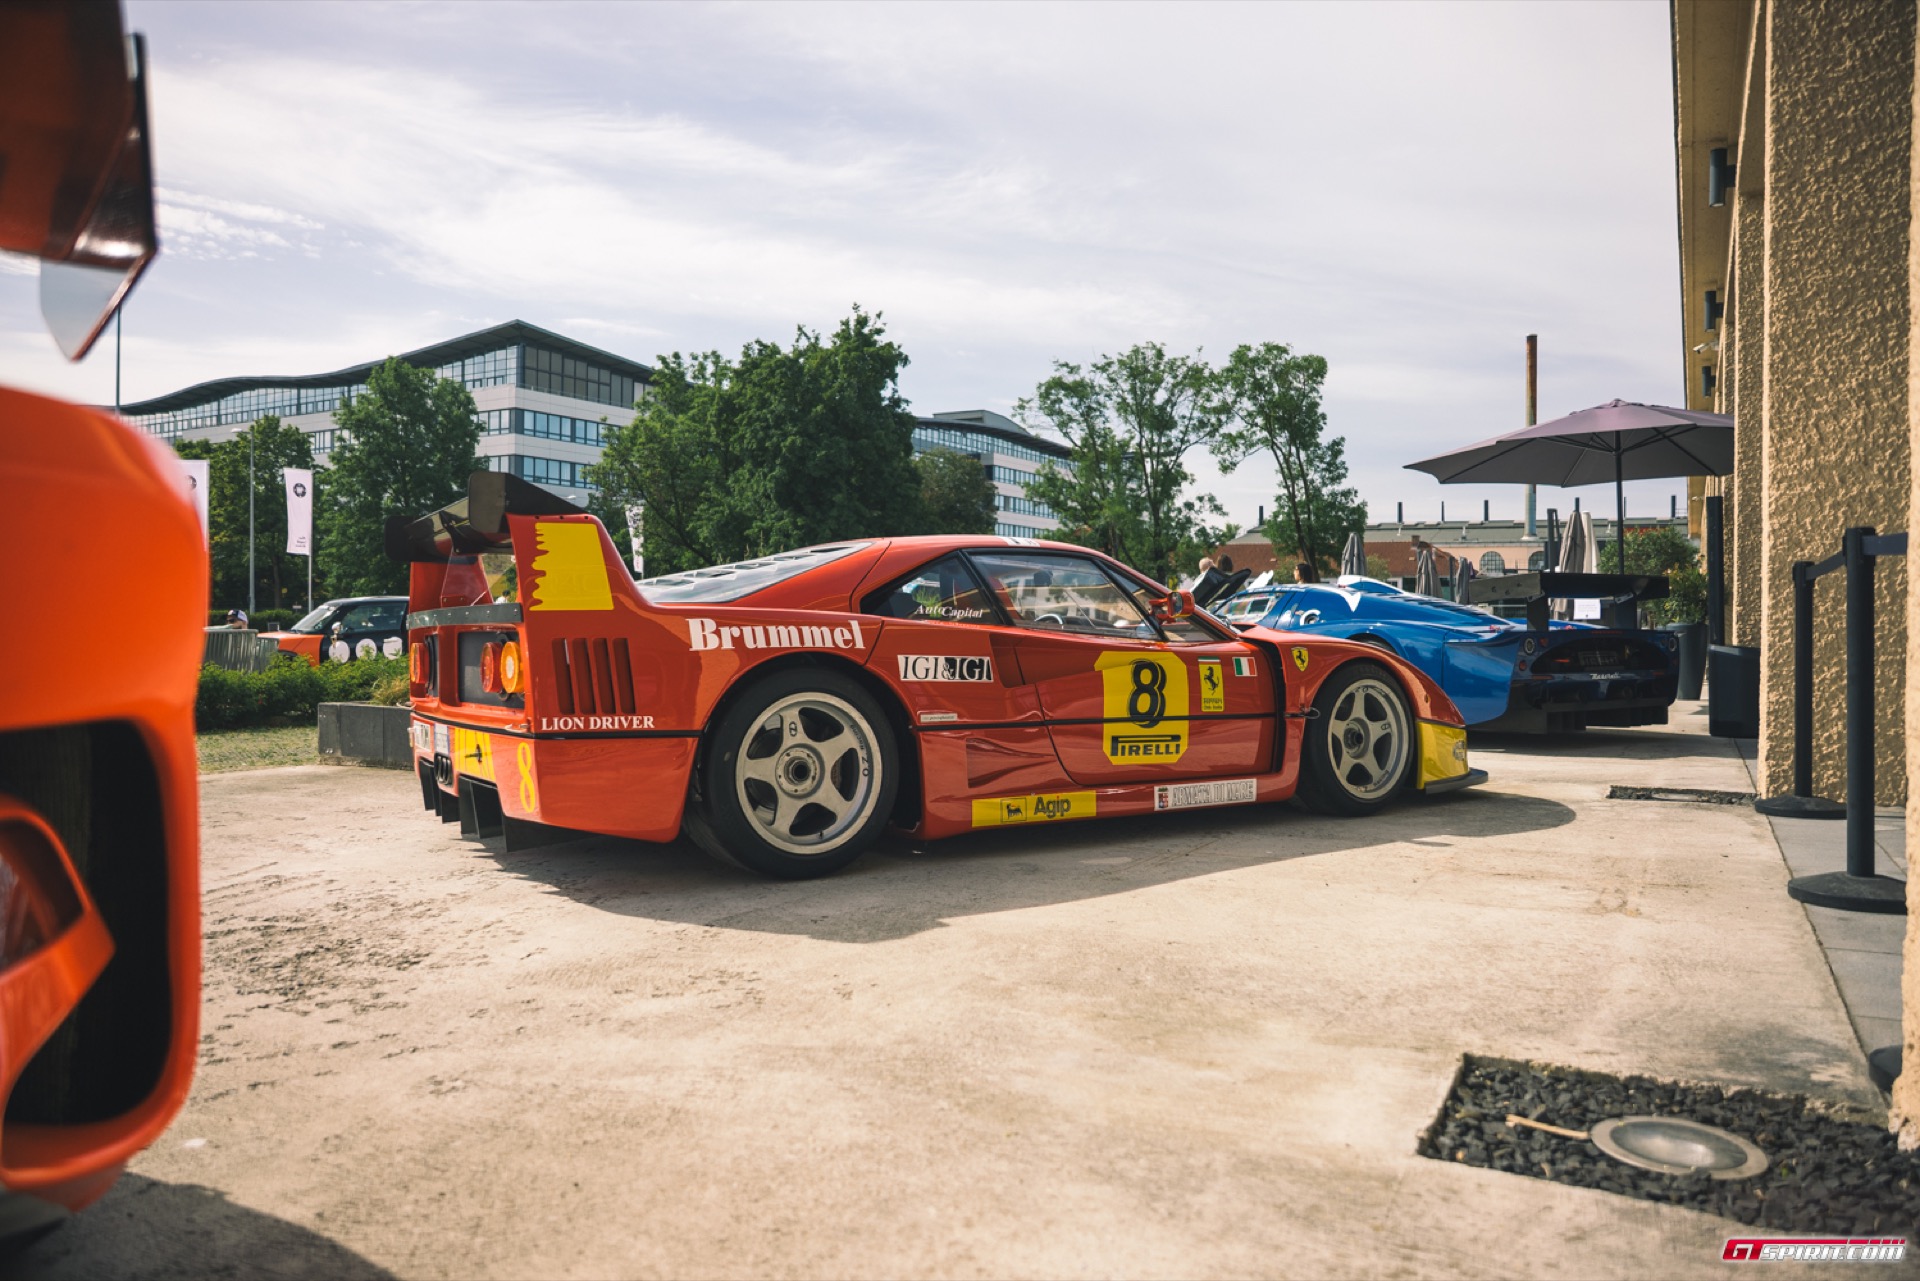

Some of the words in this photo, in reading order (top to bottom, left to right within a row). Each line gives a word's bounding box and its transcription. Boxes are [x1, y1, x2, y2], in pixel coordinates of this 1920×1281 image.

[685, 617, 866, 651] Brummel
[1127, 658, 1167, 728] 8
[541, 717, 585, 731] LION
[588, 715, 656, 730] DRIVER
[1110, 734, 1182, 757] PIRELLI
[516, 741, 536, 814] 8
[1033, 795, 1072, 818] Agip
